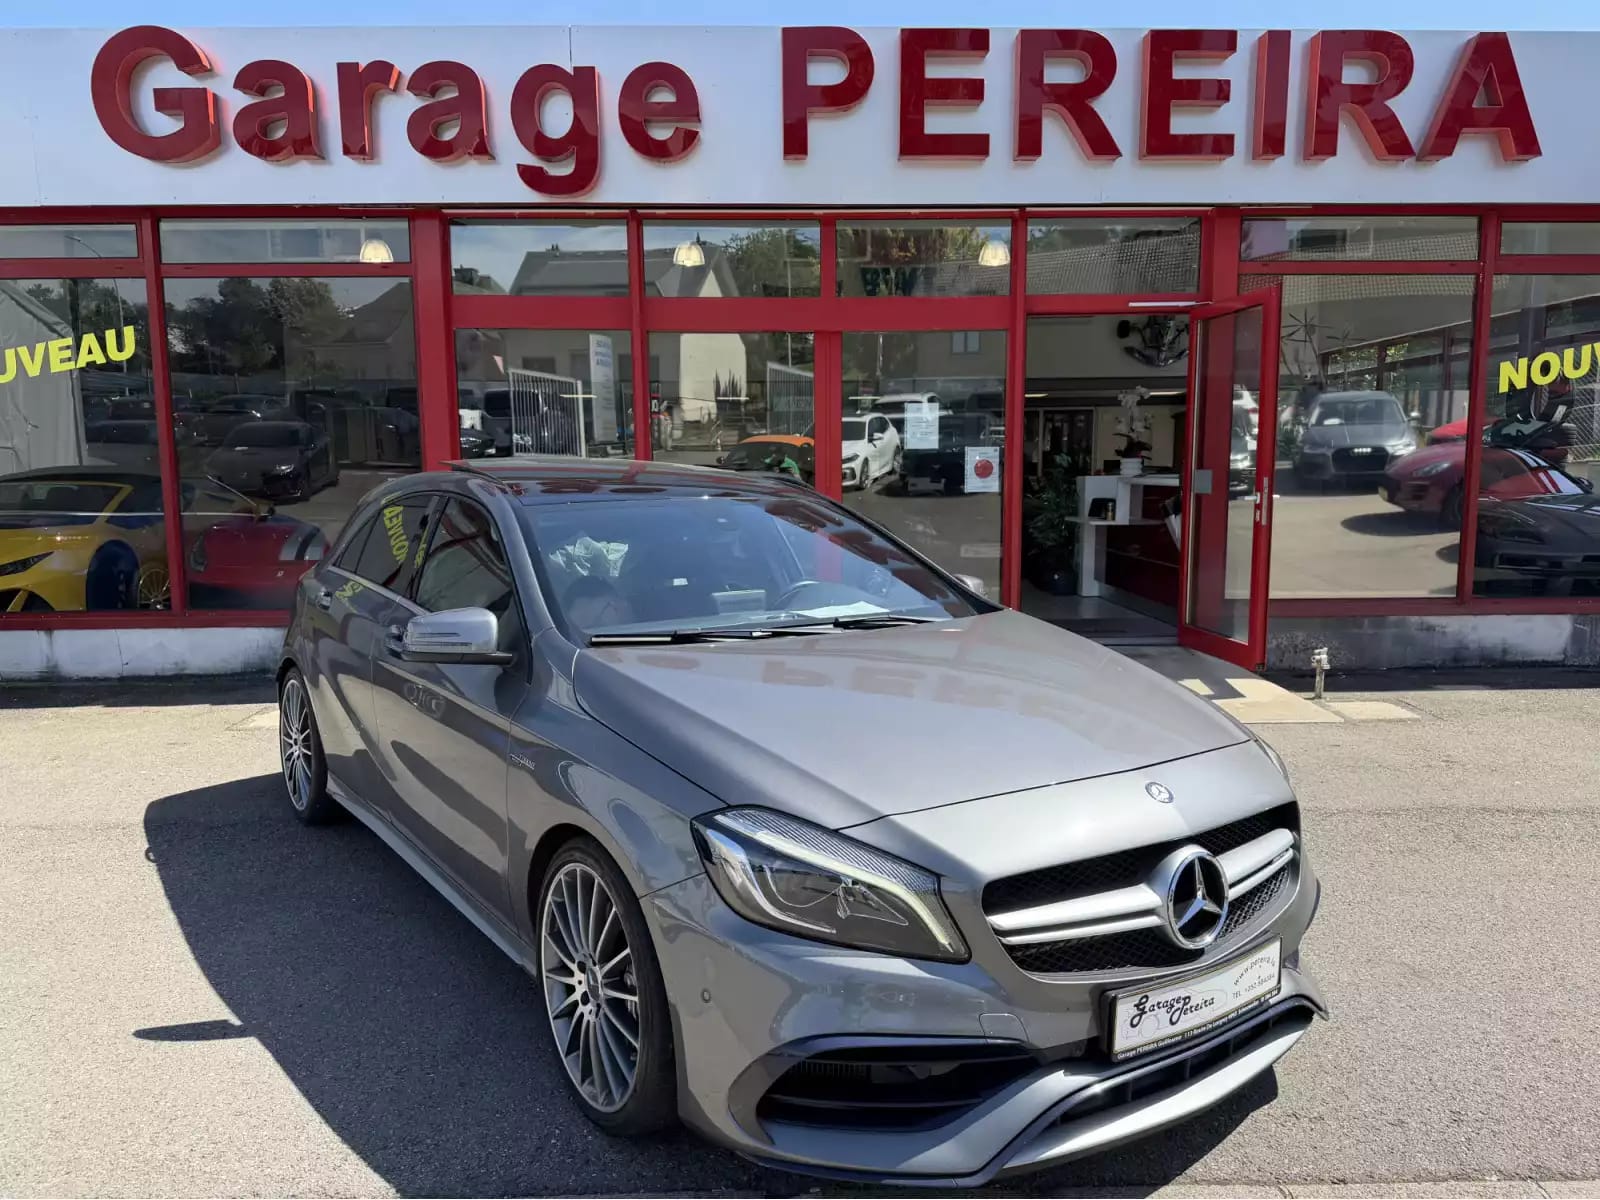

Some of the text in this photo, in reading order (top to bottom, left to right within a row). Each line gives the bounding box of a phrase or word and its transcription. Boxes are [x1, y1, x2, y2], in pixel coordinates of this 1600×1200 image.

[91, 25, 1543, 198] Garage PEREIRA
[1499, 342, 1600, 394] NOU
[1130, 994, 1182, 1028] Garage
[1169, 995, 1216, 1026] Pereira
